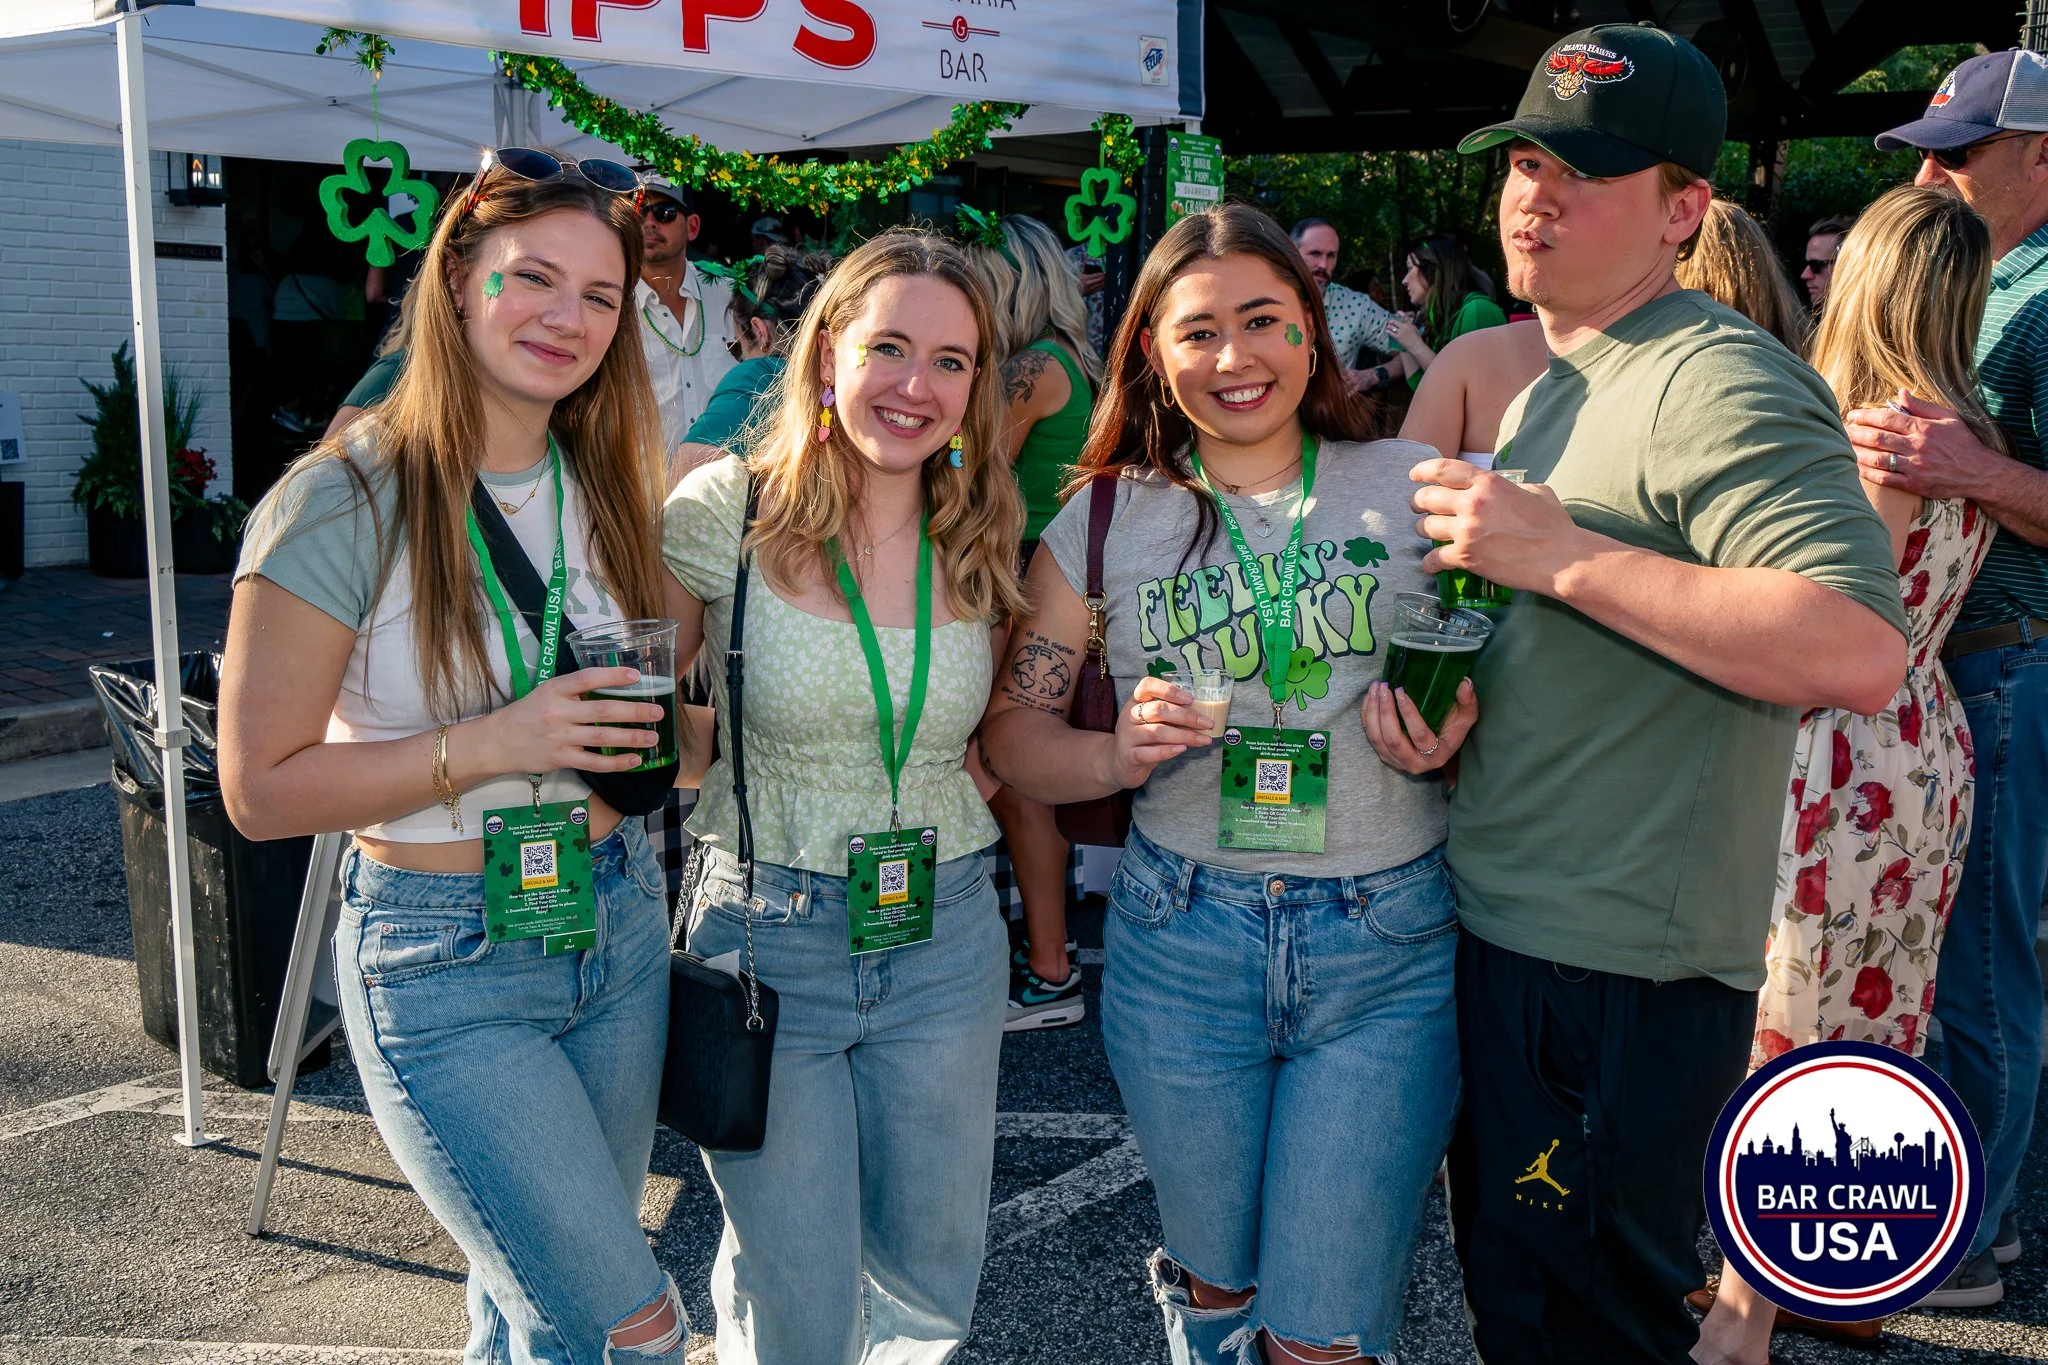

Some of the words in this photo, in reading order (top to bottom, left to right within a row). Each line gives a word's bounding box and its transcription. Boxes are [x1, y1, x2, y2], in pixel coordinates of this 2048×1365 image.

[940, 49, 987, 83] BAR
[1586, 43, 1617, 59] HAWKS
[1288, 537, 1300, 555] USA
[1236, 544, 1250, 562] BAR
[1246, 562, 1267, 600] CRAWL
[1259, 599, 1275, 628] USA
[1282, 559, 1297, 597] CRAWL
[547, 586, 562, 614] USA
[1279, 600, 1291, 628] BAR
[543, 617, 558, 666] CRAWL
[1180, 573, 1380, 690] LUKY
